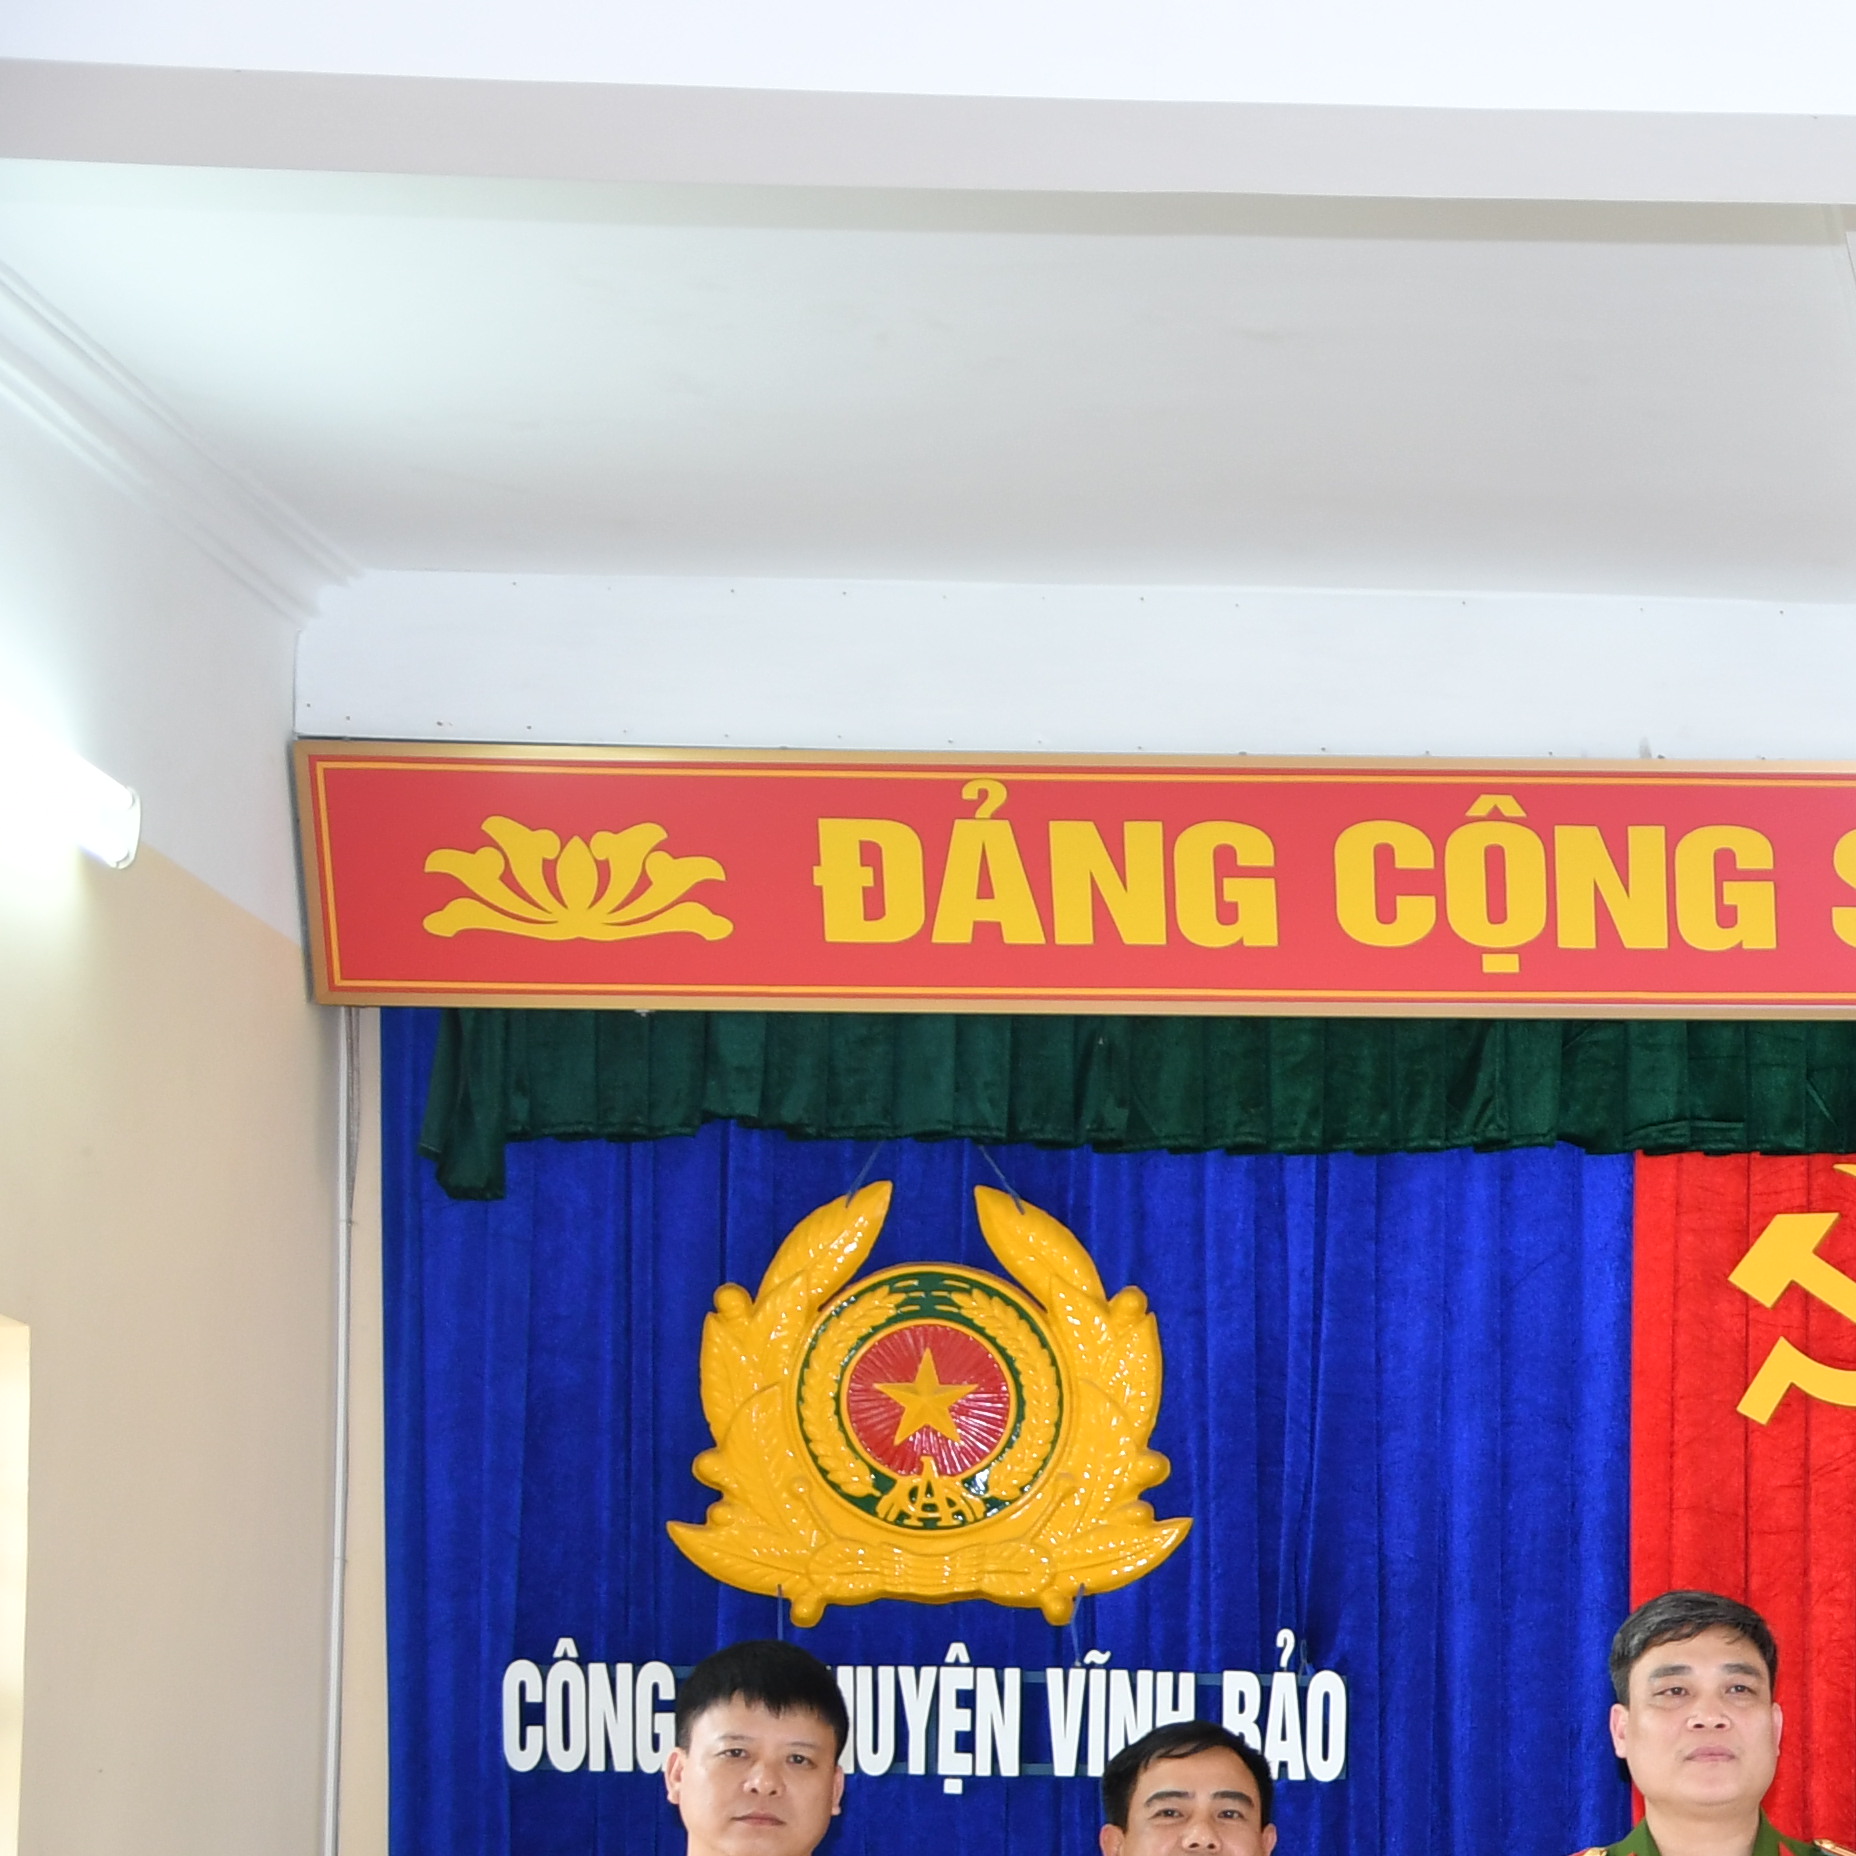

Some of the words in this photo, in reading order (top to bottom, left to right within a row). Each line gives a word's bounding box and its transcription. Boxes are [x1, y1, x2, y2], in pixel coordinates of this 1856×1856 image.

[814, 777, 1279, 949] ĐẢNG
[1334, 794, 1777, 974] CỘNG
[502, 1636, 677, 1774] CÔNG
[1222, 1627, 1348, 1782] BẢO
